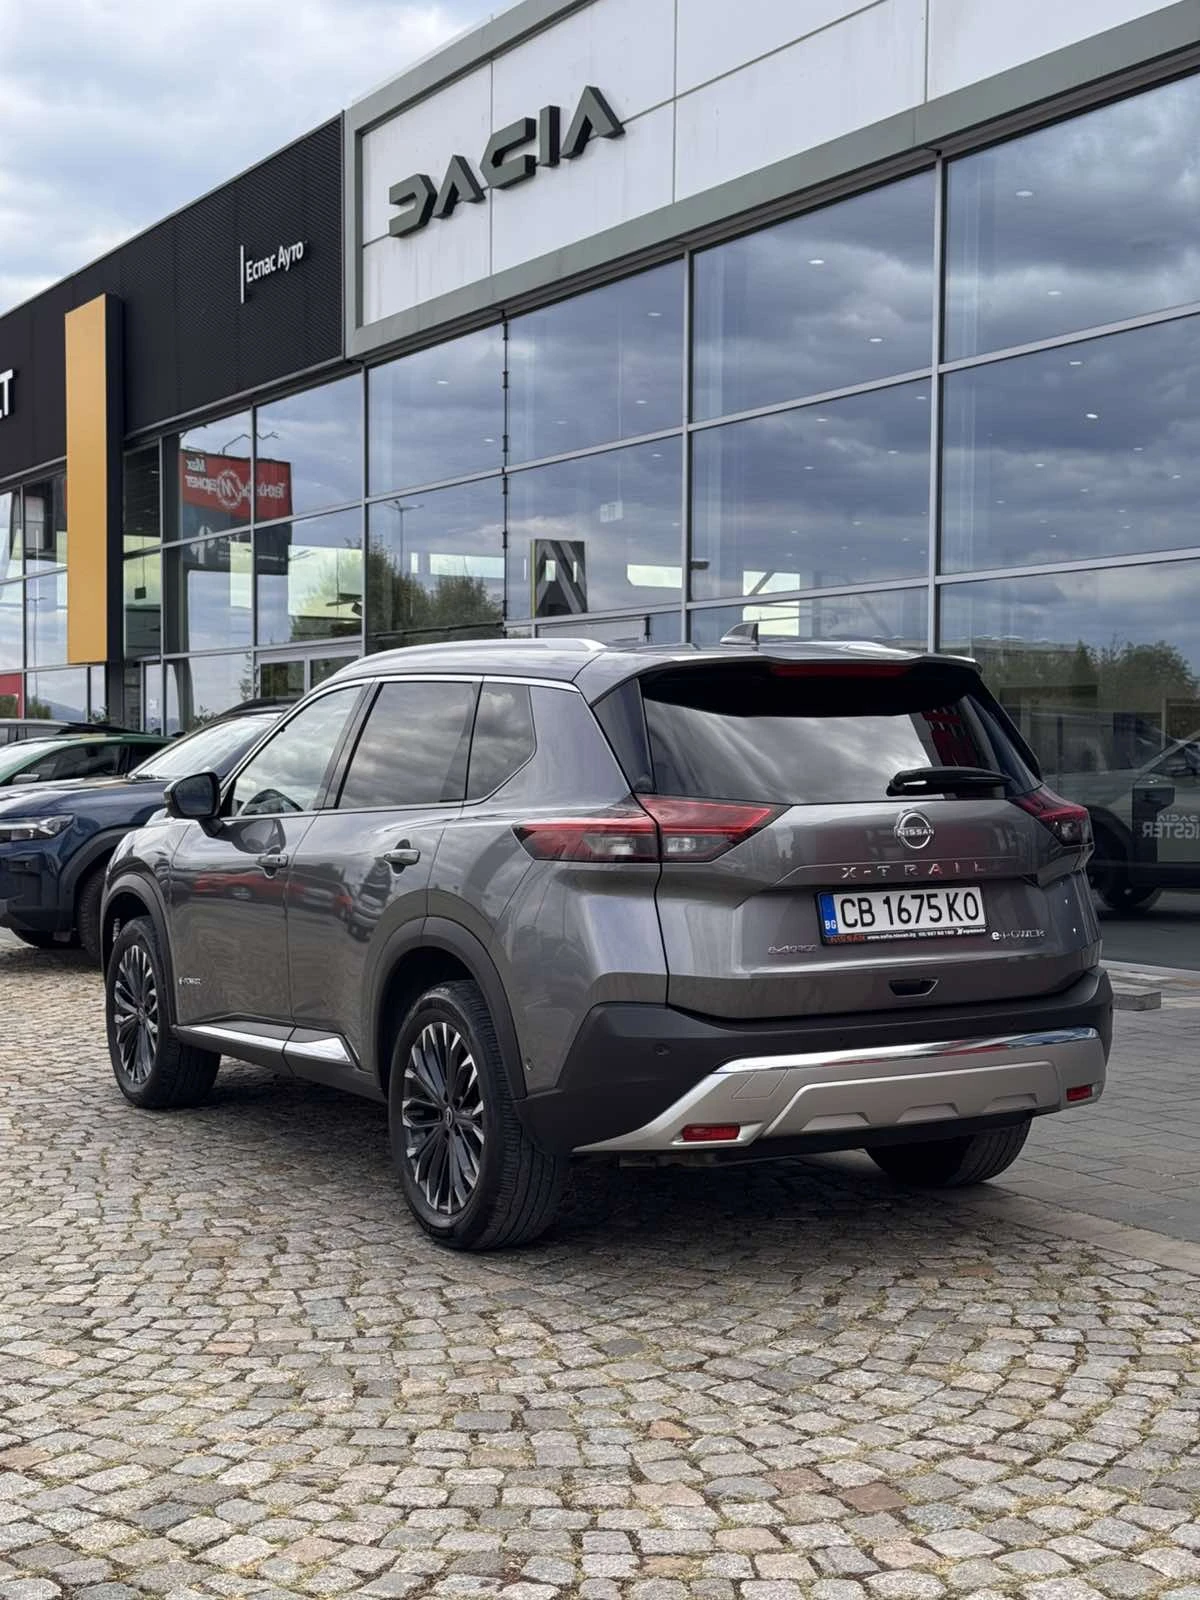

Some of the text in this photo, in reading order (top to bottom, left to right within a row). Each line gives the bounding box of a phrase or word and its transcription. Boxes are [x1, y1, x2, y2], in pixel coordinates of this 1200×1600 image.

[389, 85, 626, 237] DACIA
[246, 241, 304, 284] Еспас Ауто
[897, 828, 935, 838] NISSAN
[841, 862, 985, 879] X-TRAIL
[840, 891, 980, 928] CB 1675 KO
[824, 919, 838, 930] BG
